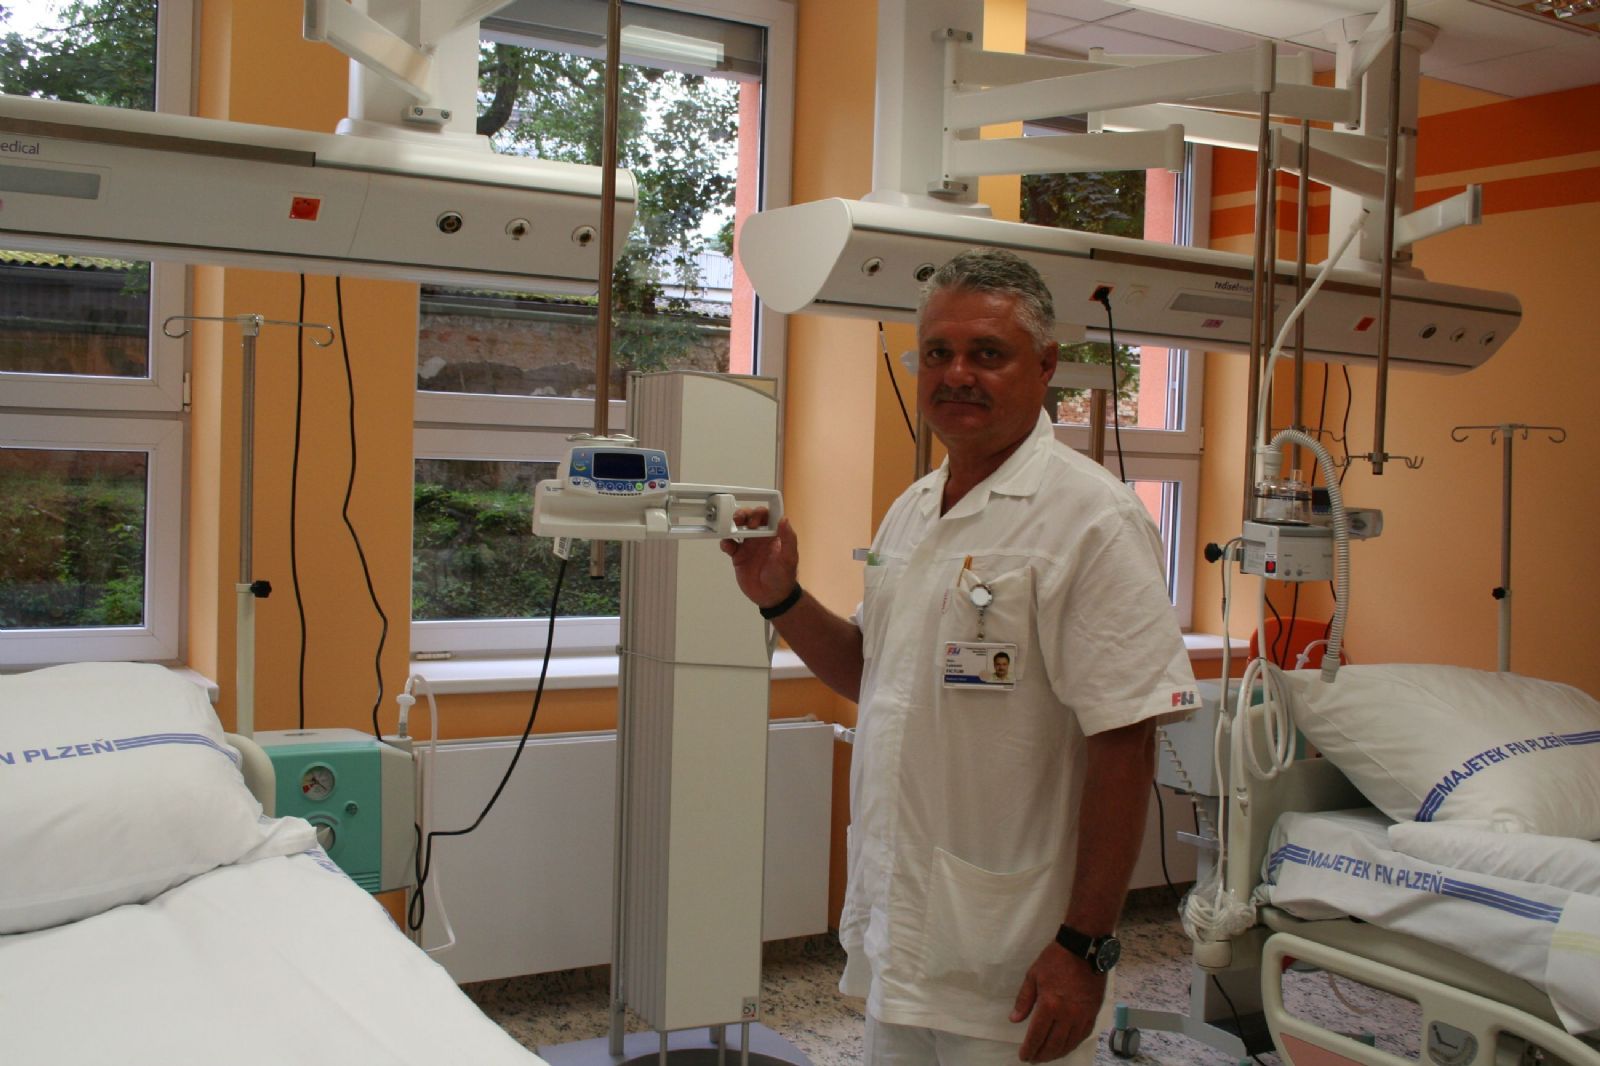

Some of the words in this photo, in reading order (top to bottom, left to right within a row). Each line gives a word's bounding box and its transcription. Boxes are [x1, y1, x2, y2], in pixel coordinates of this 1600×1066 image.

[23, 738, 114, 763] PLZEŇ
[1435, 747, 1510, 796] MAJETEK
[1504, 741, 1530, 756] FN
[1307, 850, 1371, 880] MAJETEK
[1375, 863, 1394, 885] FN
[1396, 870, 1443, 894] PLZEŇ
